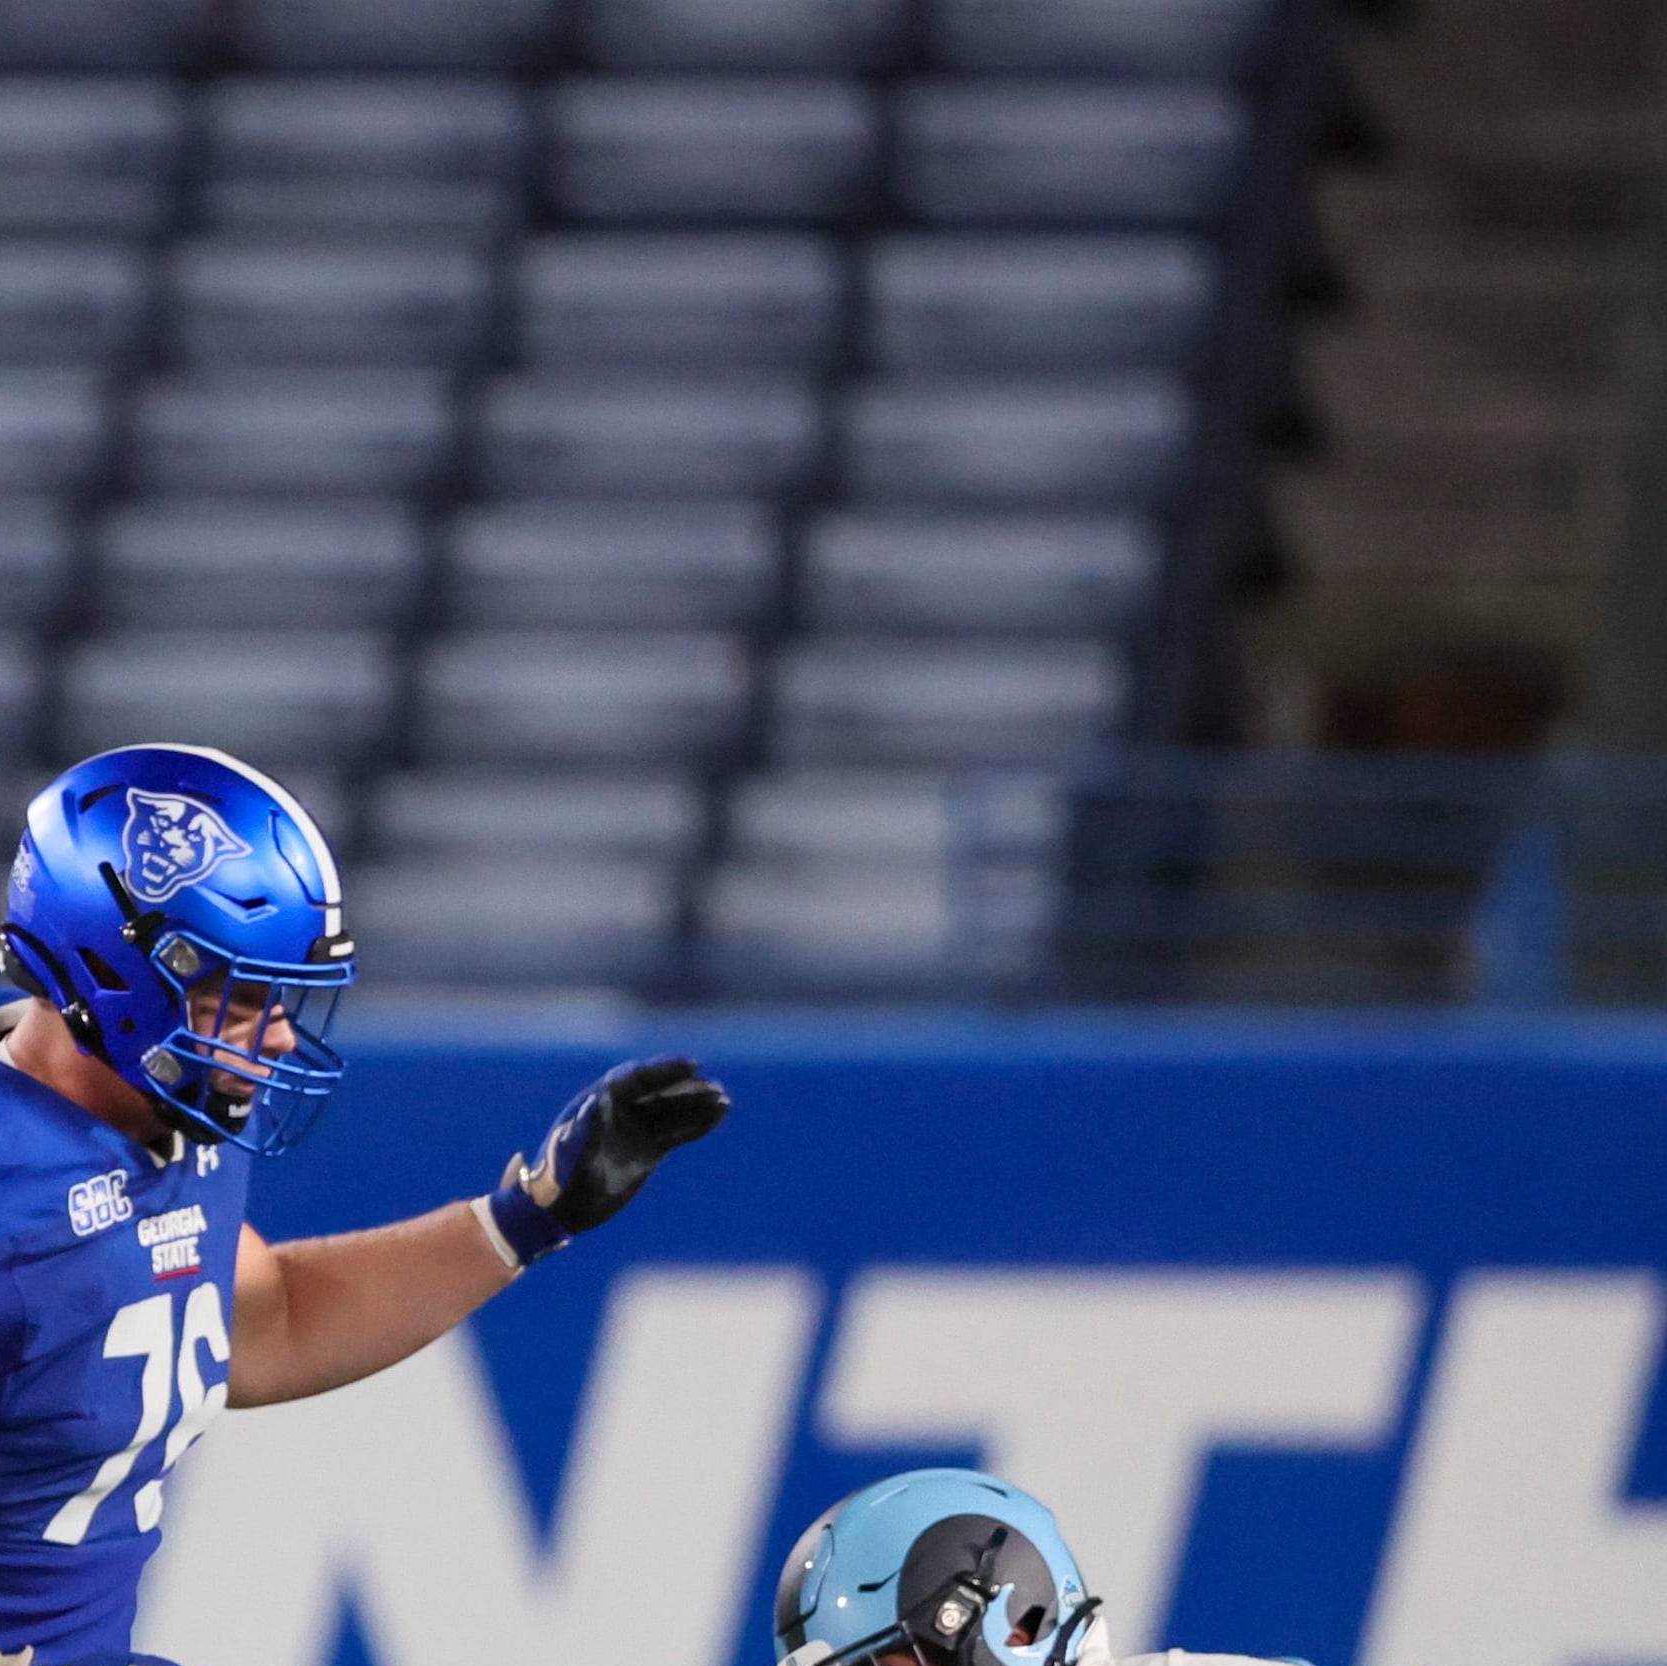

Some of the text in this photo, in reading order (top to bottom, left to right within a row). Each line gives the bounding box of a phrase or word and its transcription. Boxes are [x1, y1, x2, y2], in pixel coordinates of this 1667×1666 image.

[68, 1168, 134, 1237] SBC
[136, 1204, 208, 1248] GEORGIA
[152, 1237, 201, 1274] STATE
[42, 1281, 230, 1546] 76
